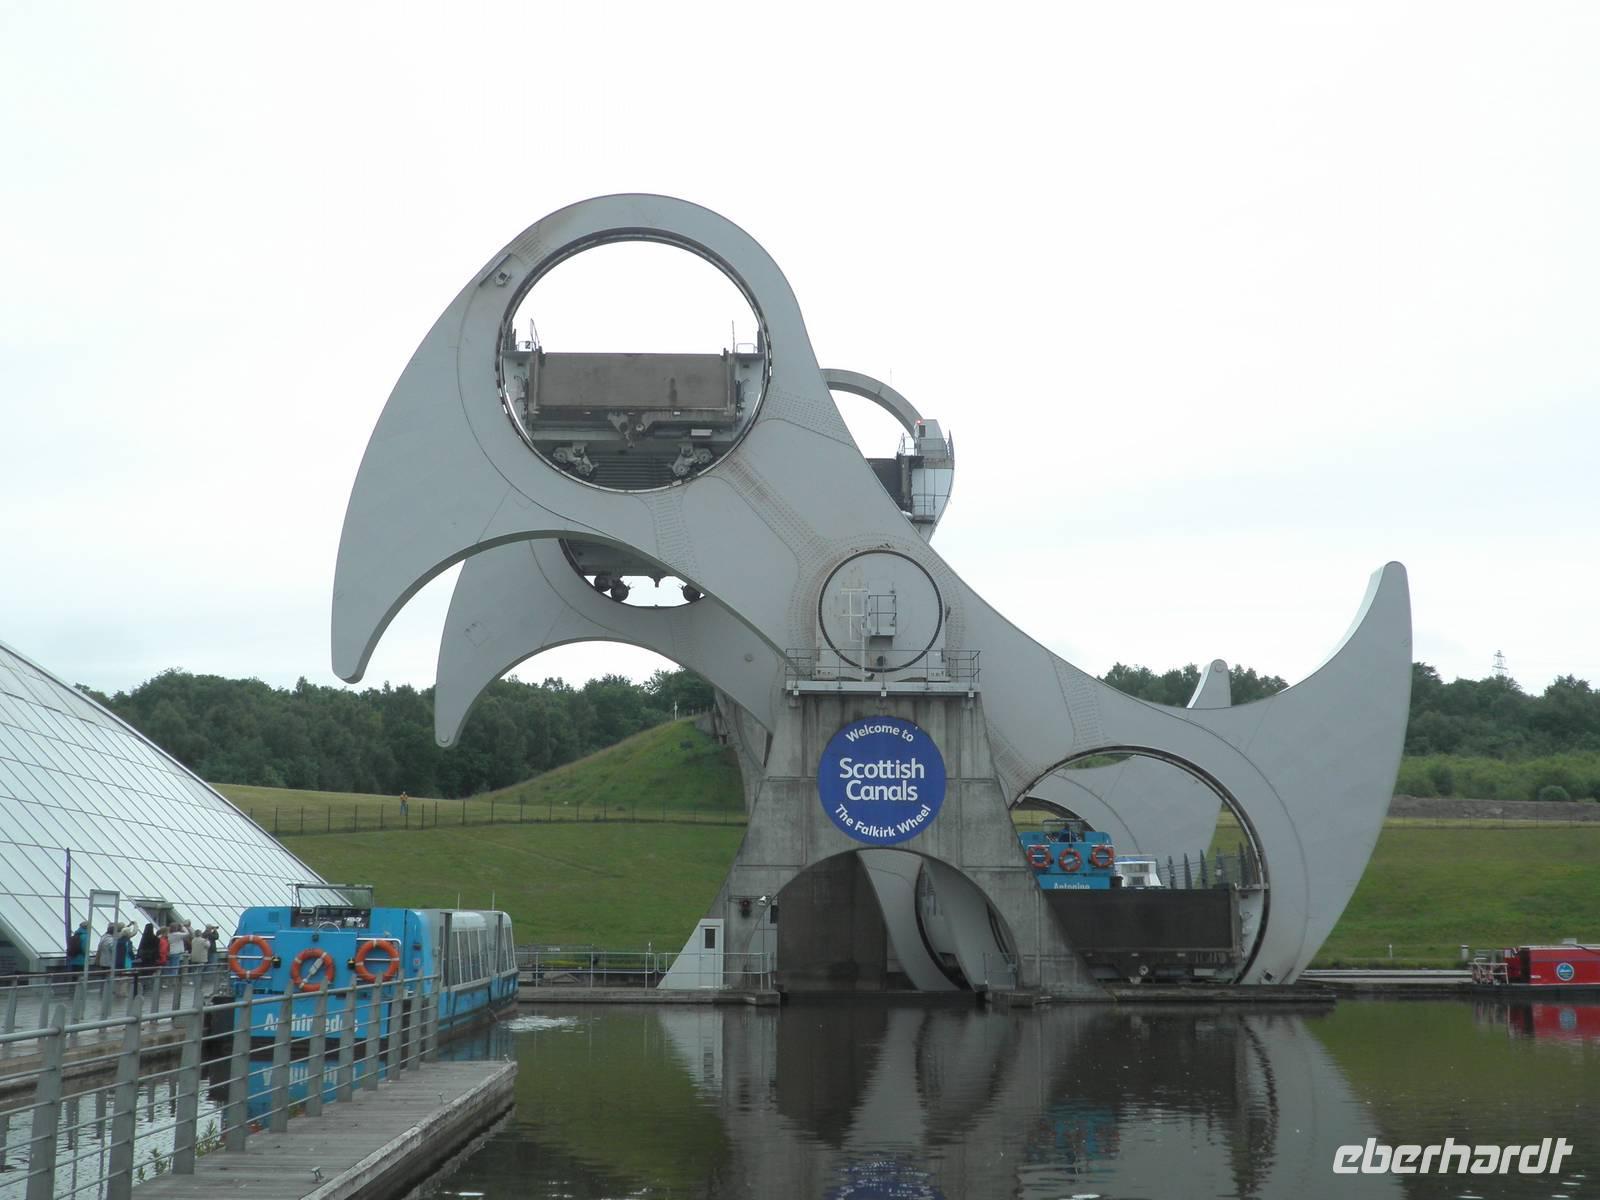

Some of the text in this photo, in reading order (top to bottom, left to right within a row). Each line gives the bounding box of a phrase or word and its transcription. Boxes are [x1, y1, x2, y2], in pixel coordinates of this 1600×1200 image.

[845, 724, 914, 742] Welcome to
[839, 757, 925, 779] Scottish
[846, 779, 918, 801] Canals
[835, 804, 932, 838] The Falkirk Wheel
